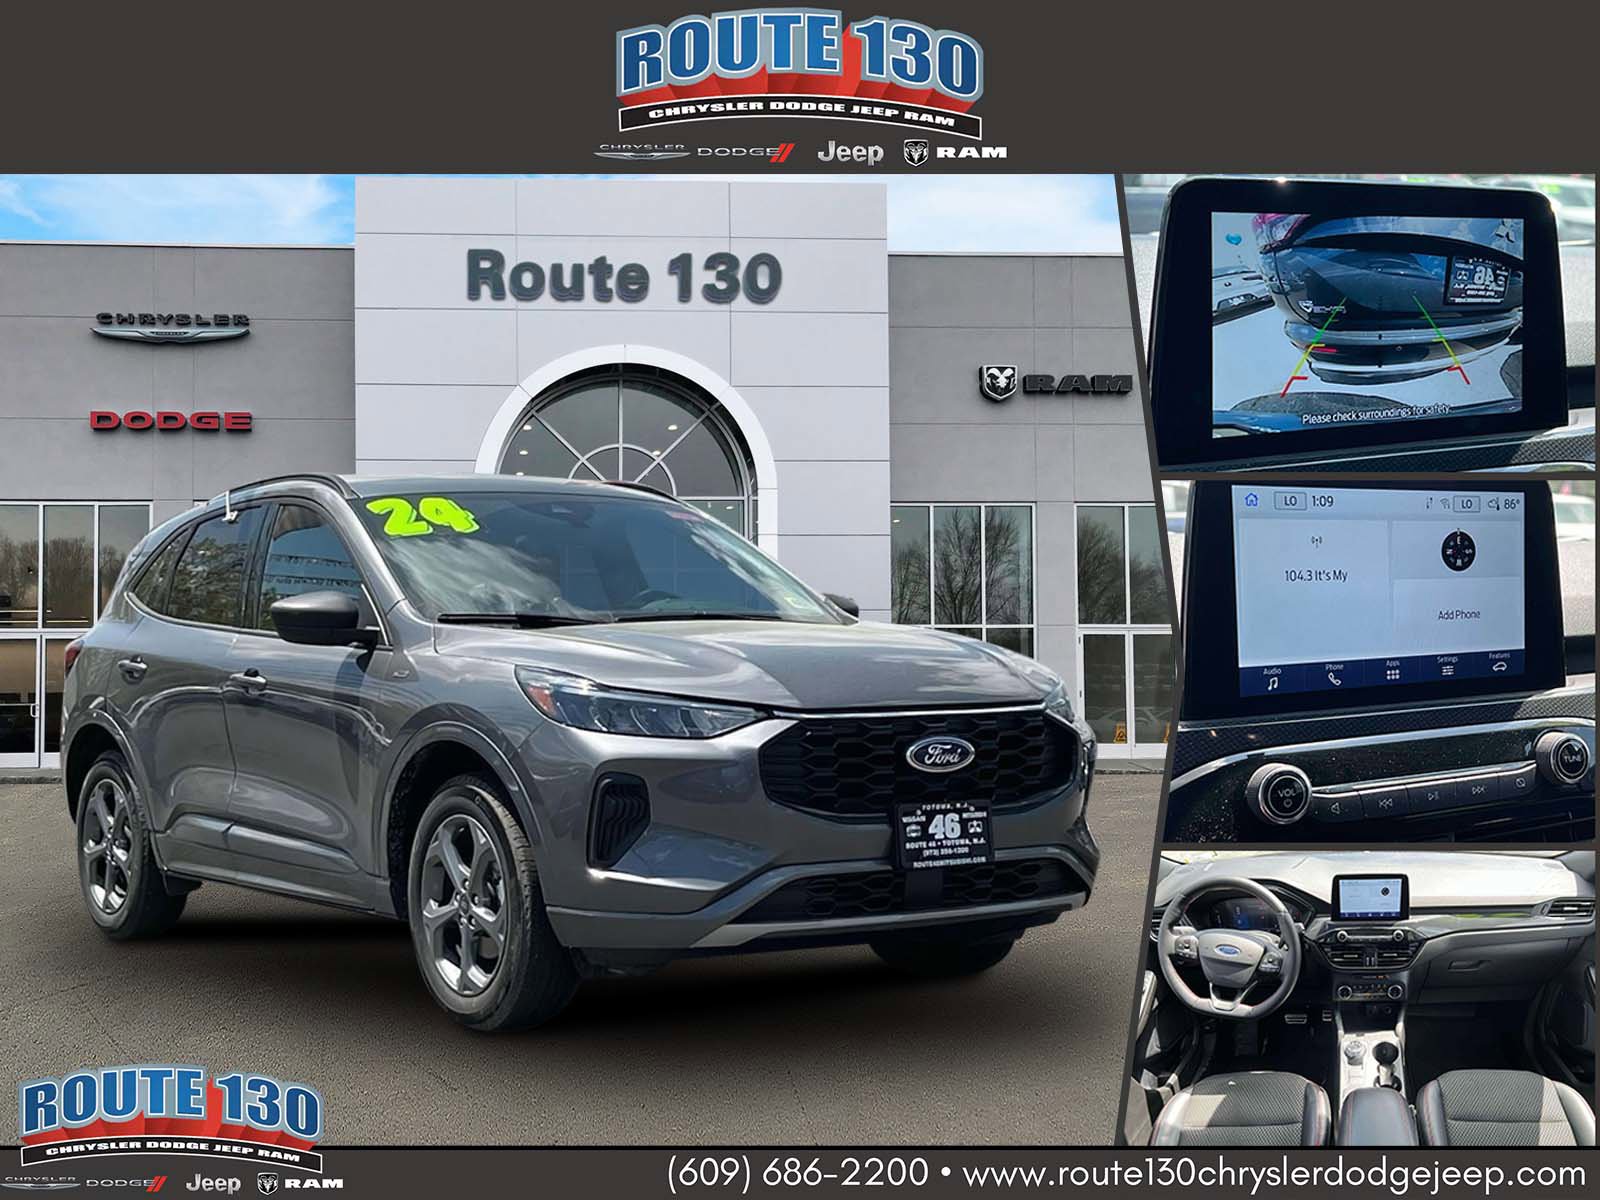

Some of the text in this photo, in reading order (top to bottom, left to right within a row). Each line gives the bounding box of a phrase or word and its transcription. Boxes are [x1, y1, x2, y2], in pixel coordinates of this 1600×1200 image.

[466, 247, 783, 305] Route 130
[96, 312, 250, 326] CHRYSLER
[1022, 374, 1133, 394] RAM
[89, 410, 252, 432] DODGE
[1302, 411, 1332, 425] Please
[1332, 410, 1357, 423] check
[1357, 406, 1411, 420] surroundings
[1412, 405, 1424, 416] for
[1284, 494, 1335, 508] LO 1:09
[1461, 498, 1473, 510] LO
[366, 497, 480, 537] 24
[1284, 568, 1348, 583] 104.3 It's My
[1438, 608, 1480, 621] Add Phone
[1263, 667, 1282, 675] Audio
[1325, 663, 1344, 671] Phone
[924, 743, 962, 765] Ford
[1278, 788, 1296, 798] VOL
[928, 812, 961, 840] 46
